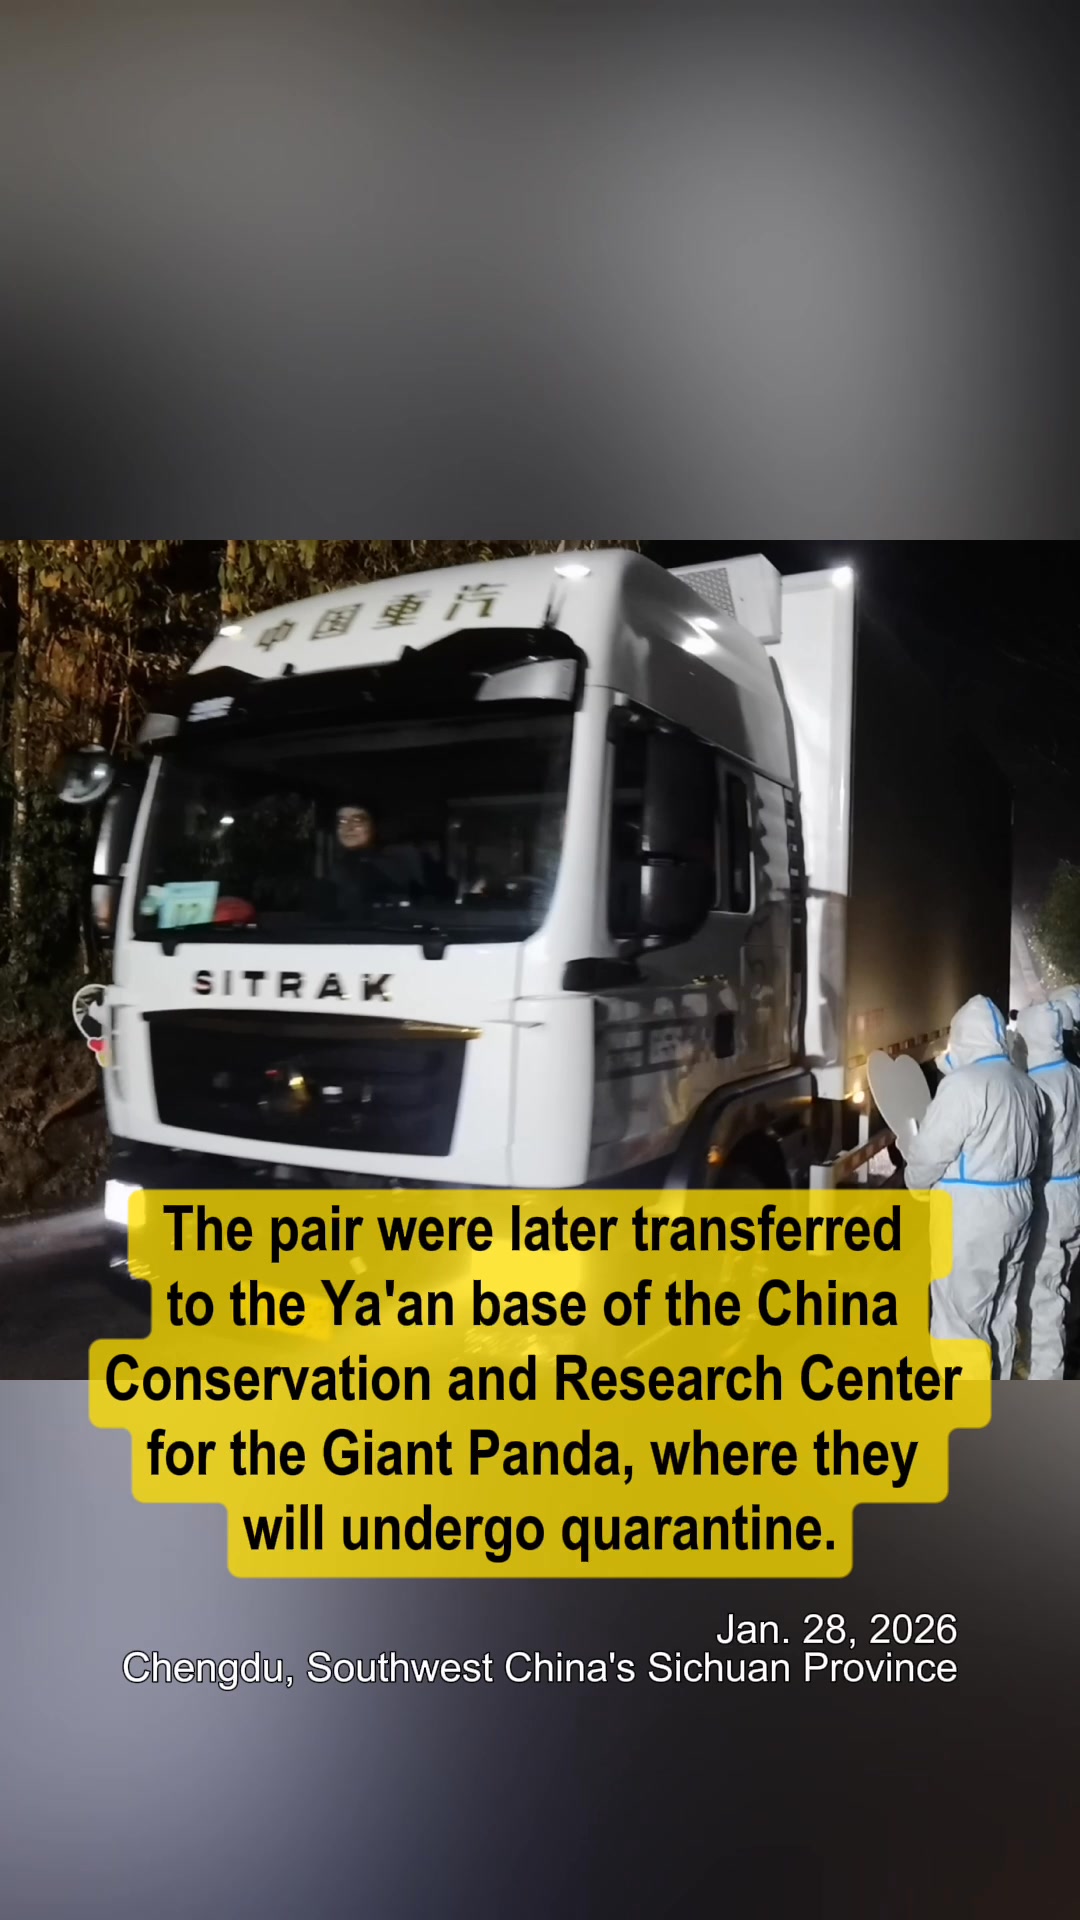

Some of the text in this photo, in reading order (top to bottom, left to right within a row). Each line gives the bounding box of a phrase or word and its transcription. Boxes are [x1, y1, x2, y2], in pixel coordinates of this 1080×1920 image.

[255, 582, 508, 652] 中国重汽
[193, 969, 395, 1003] SITRAK
